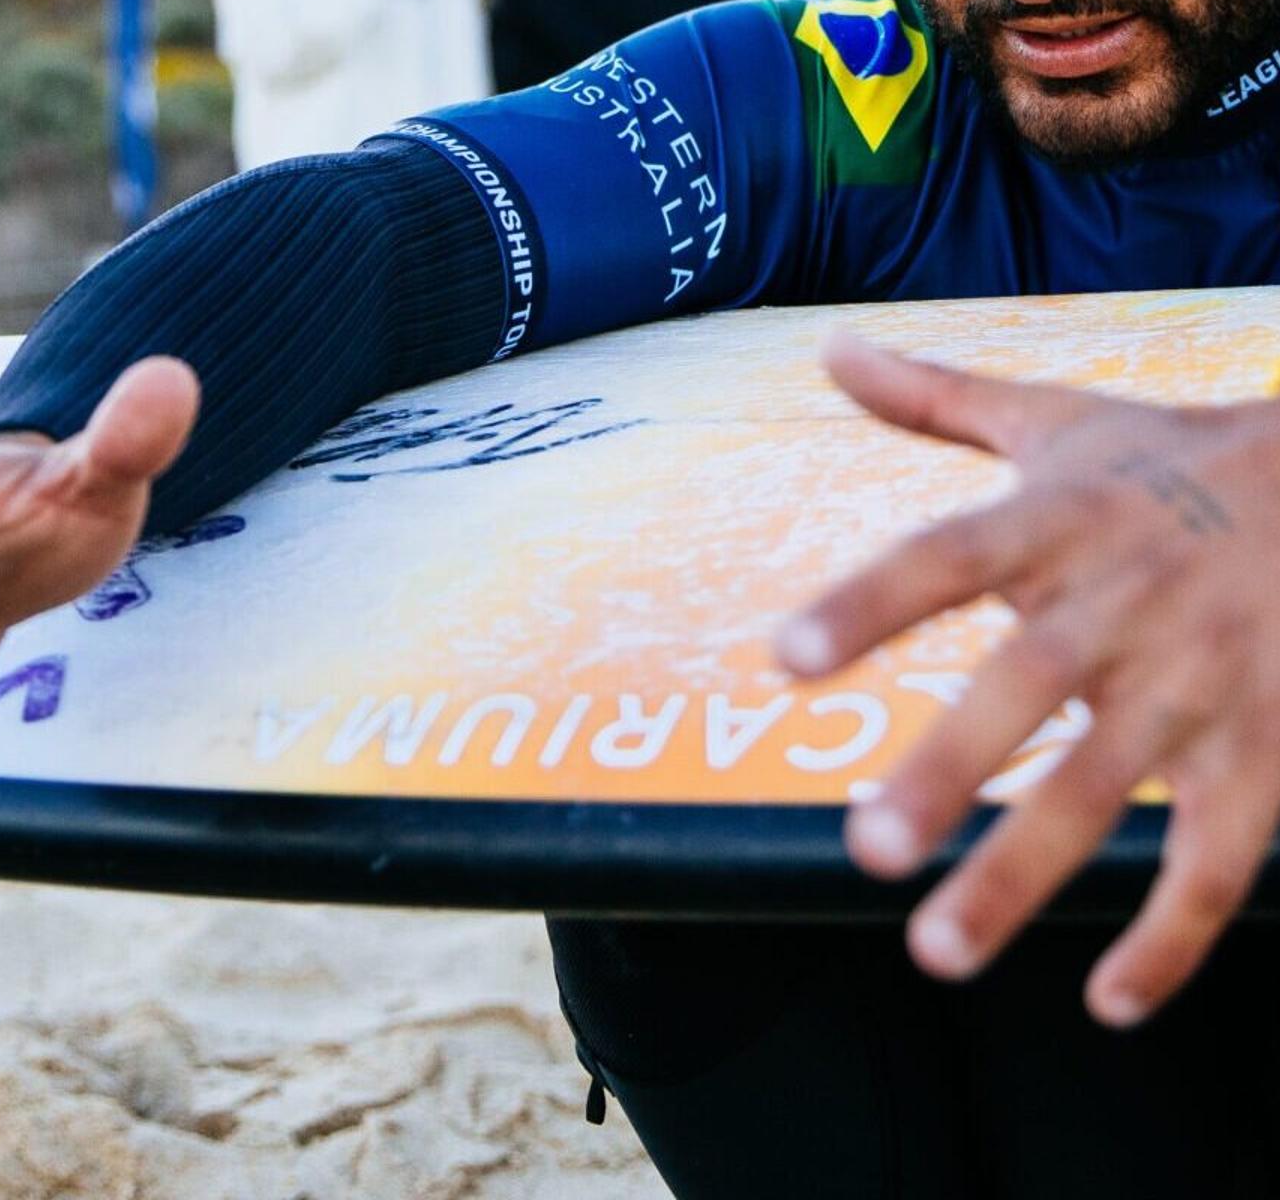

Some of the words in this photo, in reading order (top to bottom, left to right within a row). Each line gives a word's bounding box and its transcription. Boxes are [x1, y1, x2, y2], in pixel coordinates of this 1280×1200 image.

[405, 122, 533, 297] CHAMPIONSHIP
[549, 75, 694, 303] USTRALIA
[251, 691, 890, 773] CARIUMA
